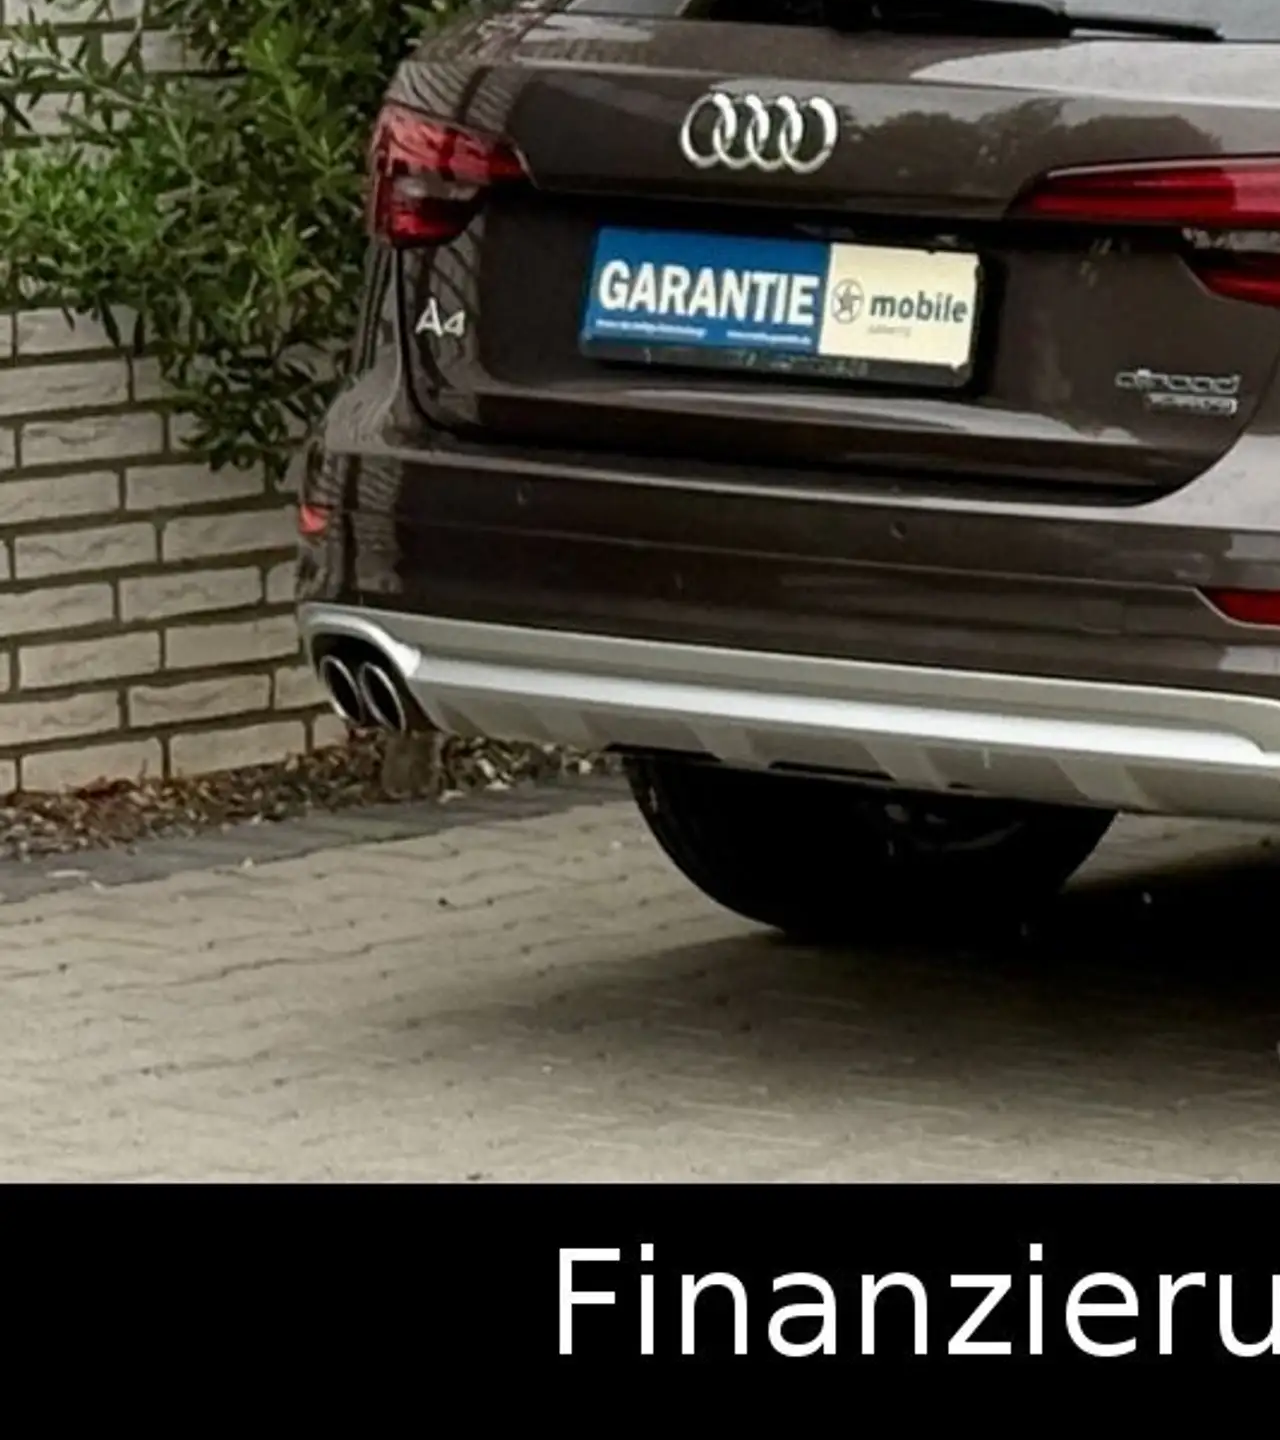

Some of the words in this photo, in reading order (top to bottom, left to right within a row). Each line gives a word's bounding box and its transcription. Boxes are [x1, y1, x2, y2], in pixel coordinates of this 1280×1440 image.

[600, 260, 819, 326] GARANTIE
[869, 289, 968, 324] mobile
[414, 296, 466, 338] A4
